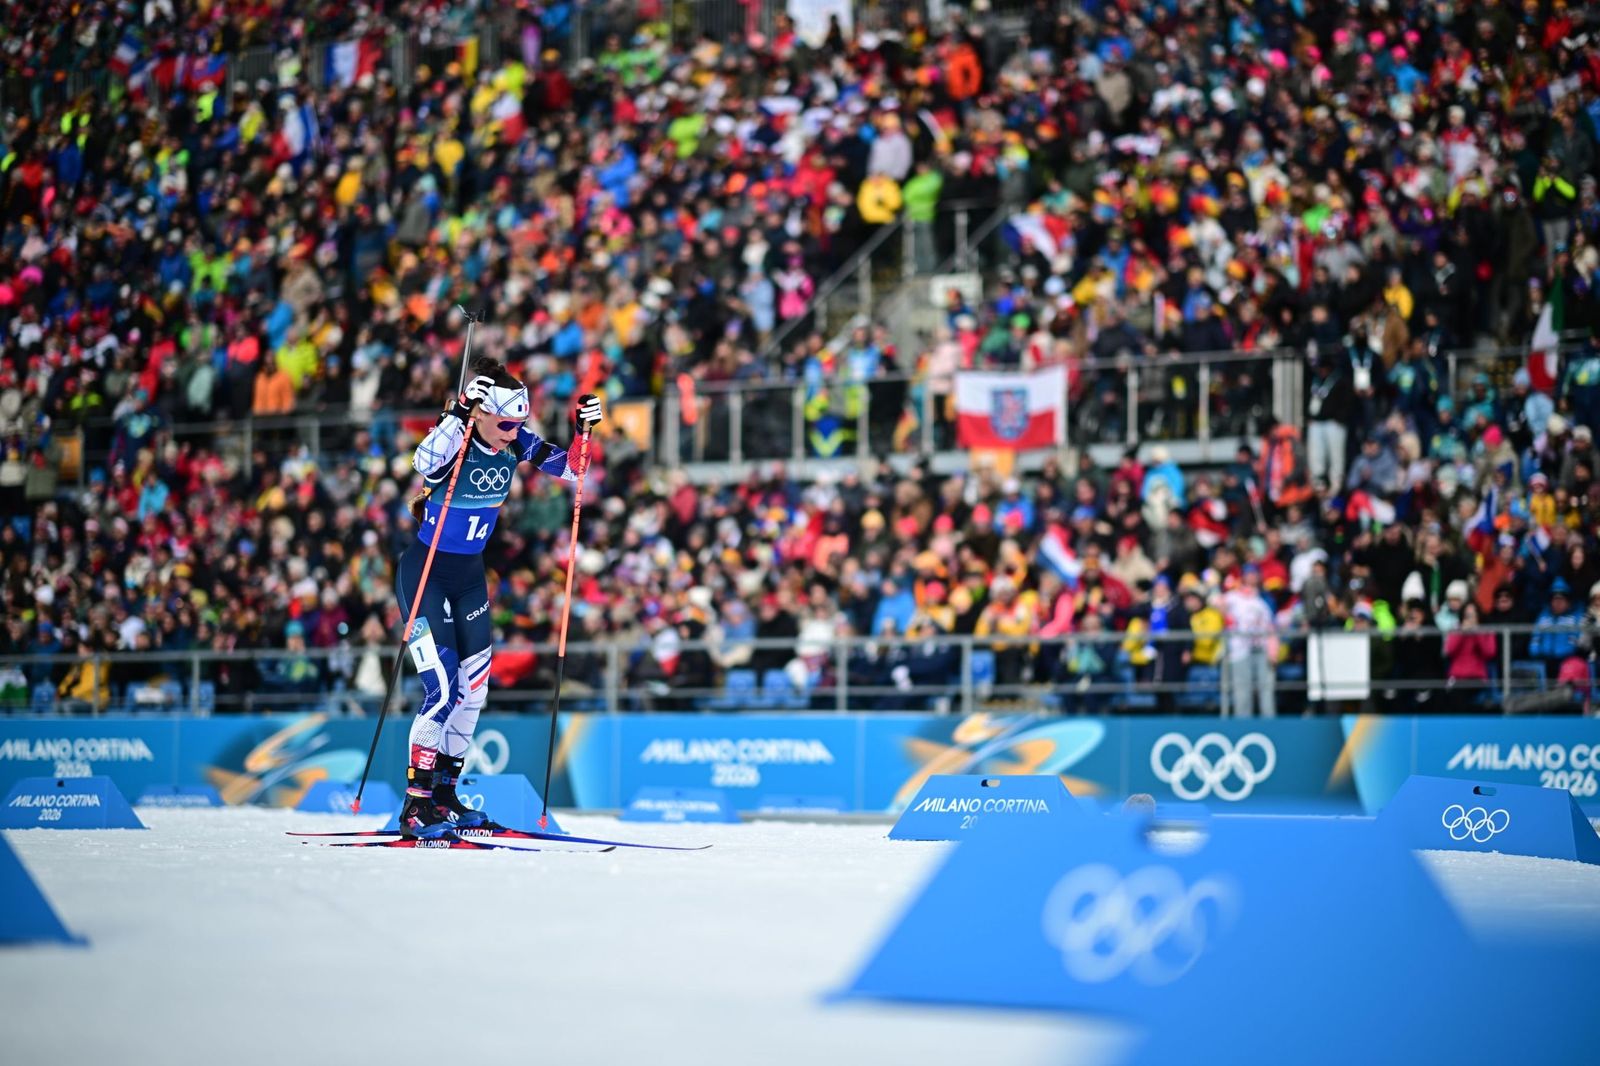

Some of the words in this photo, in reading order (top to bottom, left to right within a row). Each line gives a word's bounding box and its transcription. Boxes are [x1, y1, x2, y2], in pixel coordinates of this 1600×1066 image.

[466, 515, 489, 541] 14
[416, 646, 425, 662] 1
[0, 738, 73, 761] MILANO
[74, 738, 154, 761] CORTINA
[640, 738, 734, 763] MILANO
[735, 738, 835, 764] CORTINA
[1447, 743, 1566, 770] MILANO
[1541, 771, 1598, 796] 2026
[9, 794, 57, 807] MILANO
[57, 794, 101, 807] CORTINA
[913, 797, 981, 812] MILANO
[983, 798, 1050, 814] CORTINA
[38, 808, 62, 821] 2026
[960, 815, 978, 830] 20
[453, 829, 493, 837] ALOMON
[415, 841, 451, 849] SALOMON
